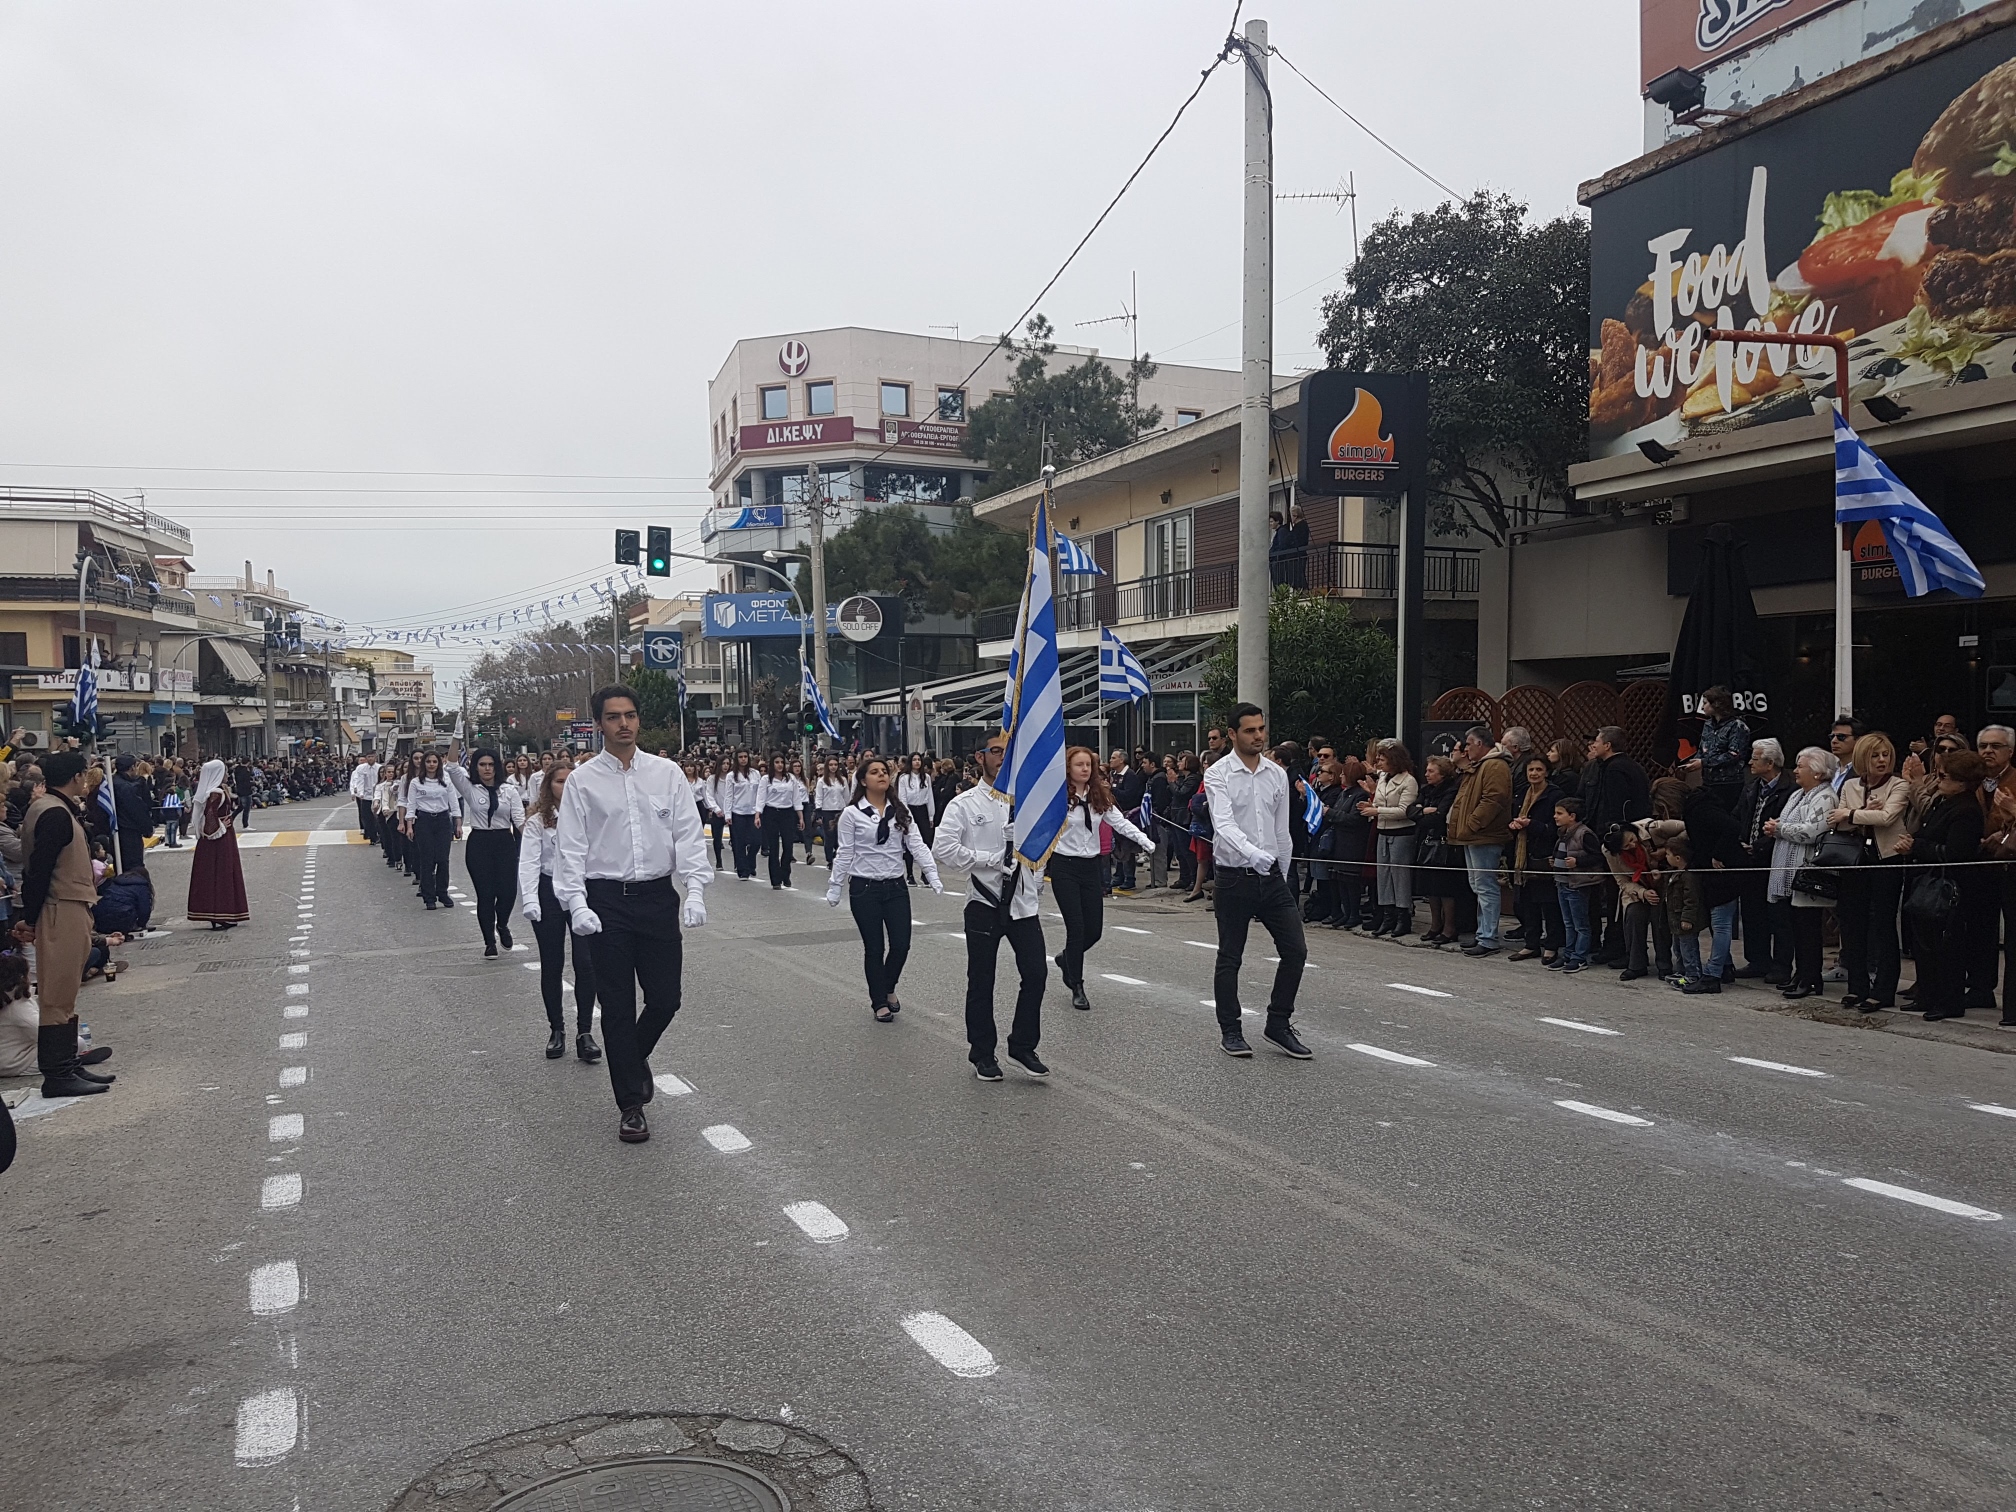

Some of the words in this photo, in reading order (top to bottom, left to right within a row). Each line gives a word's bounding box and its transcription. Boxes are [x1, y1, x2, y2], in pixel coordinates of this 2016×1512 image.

[1648, 166, 1771, 341] Food
[1634, 321, 1707, 399] we
[1338, 443, 1388, 462] simply
[1334, 468, 1385, 481] BURGERS
[1860, 543, 1892, 559] simp
[1861, 566, 1901, 581] BURGE
[751, 599, 789, 608] ΦΡΟΝ
[842, 622, 860, 631] SOLO
[861, 622, 879, 631] CAFE
[43, 674, 76, 684] ΣΥΡΙΖ
